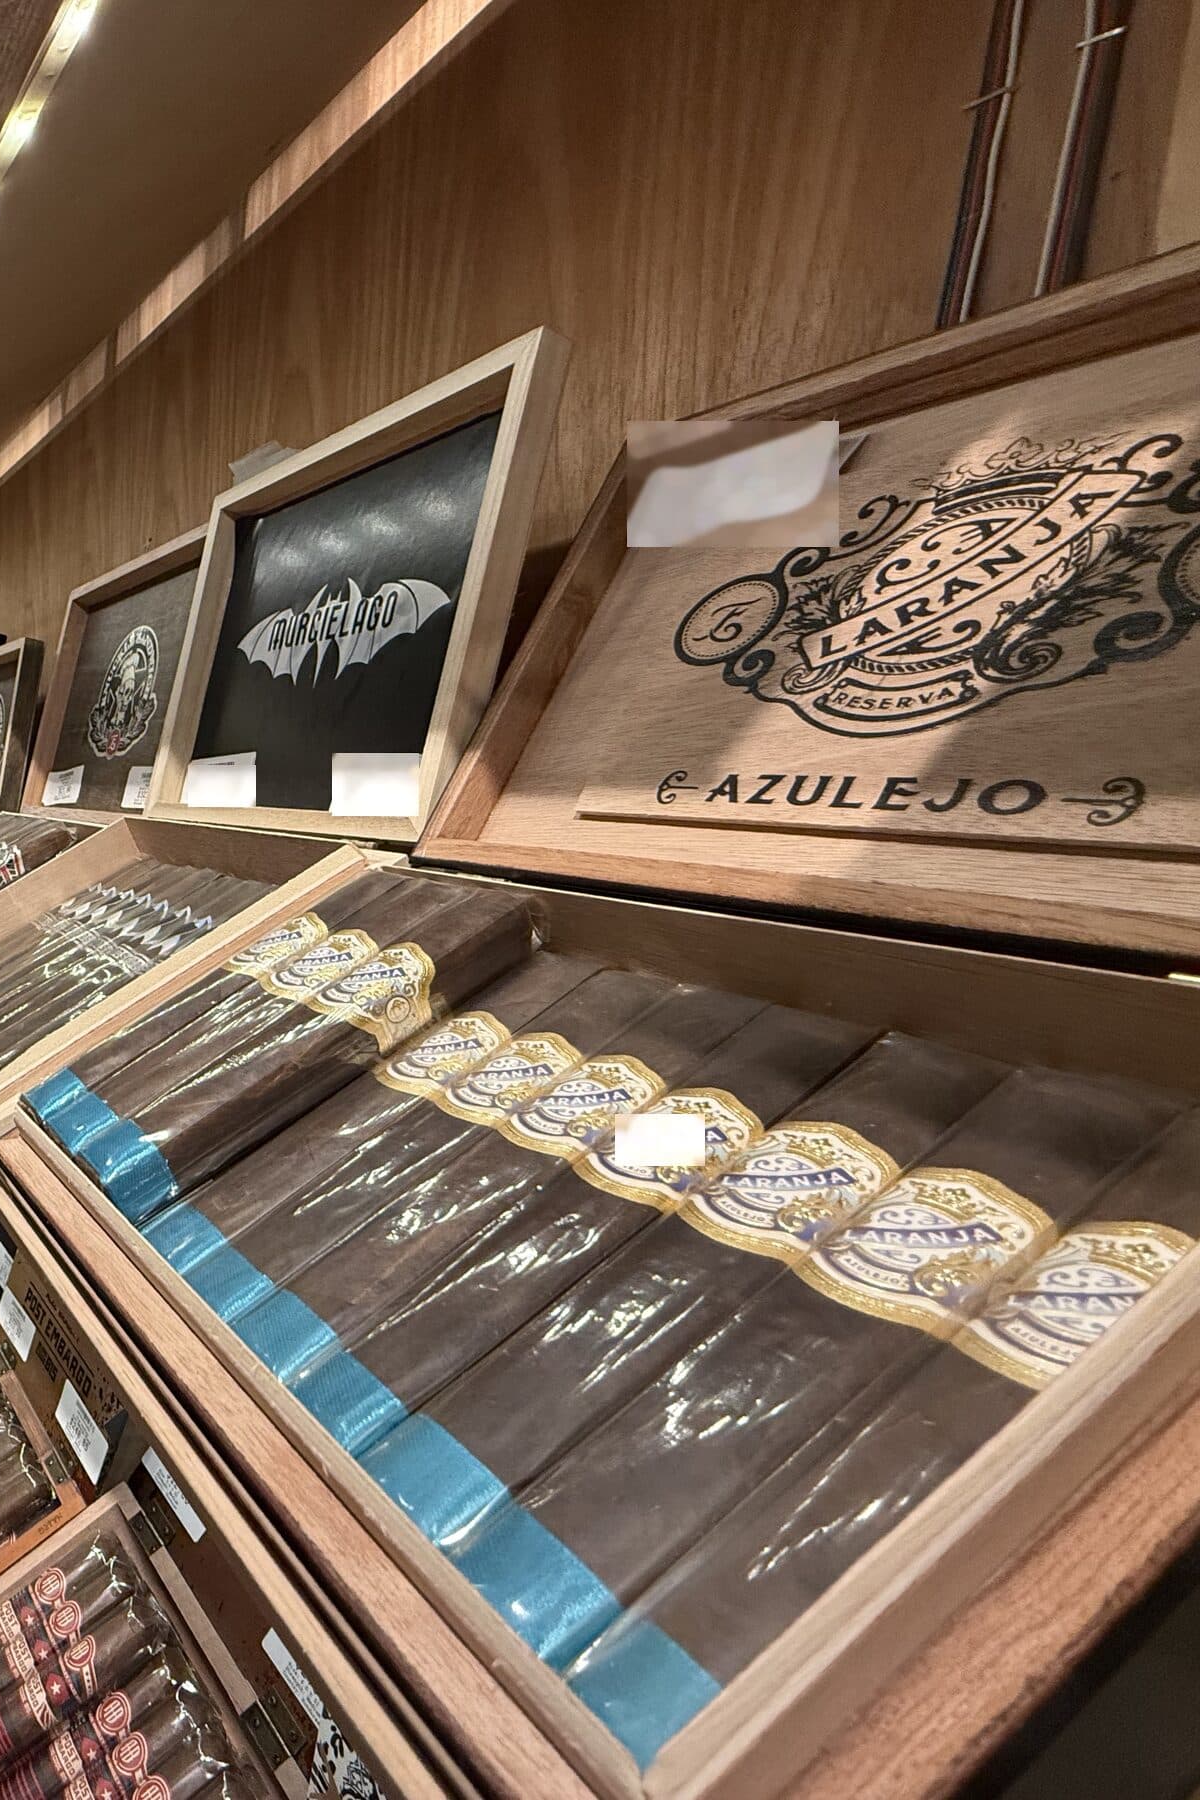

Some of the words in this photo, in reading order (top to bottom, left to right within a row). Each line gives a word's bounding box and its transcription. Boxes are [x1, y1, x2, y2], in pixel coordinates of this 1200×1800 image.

[820, 489, 1121, 659] LARANJA
[832, 687, 955, 710] RESERVA
[705, 772, 1049, 816] AZULEJO
[722, 1170, 849, 1188] LARANJA
[844, 1227, 997, 1247] LARANJA
[843, 1255, 901, 1286] AZULEJO
[1008, 1293, 1140, 1314] LARAN
[24, 1287, 47, 1325] POST
[45, 1320, 94, 1398] EMBARGO
[62, 1735, 79, 1763] POST
